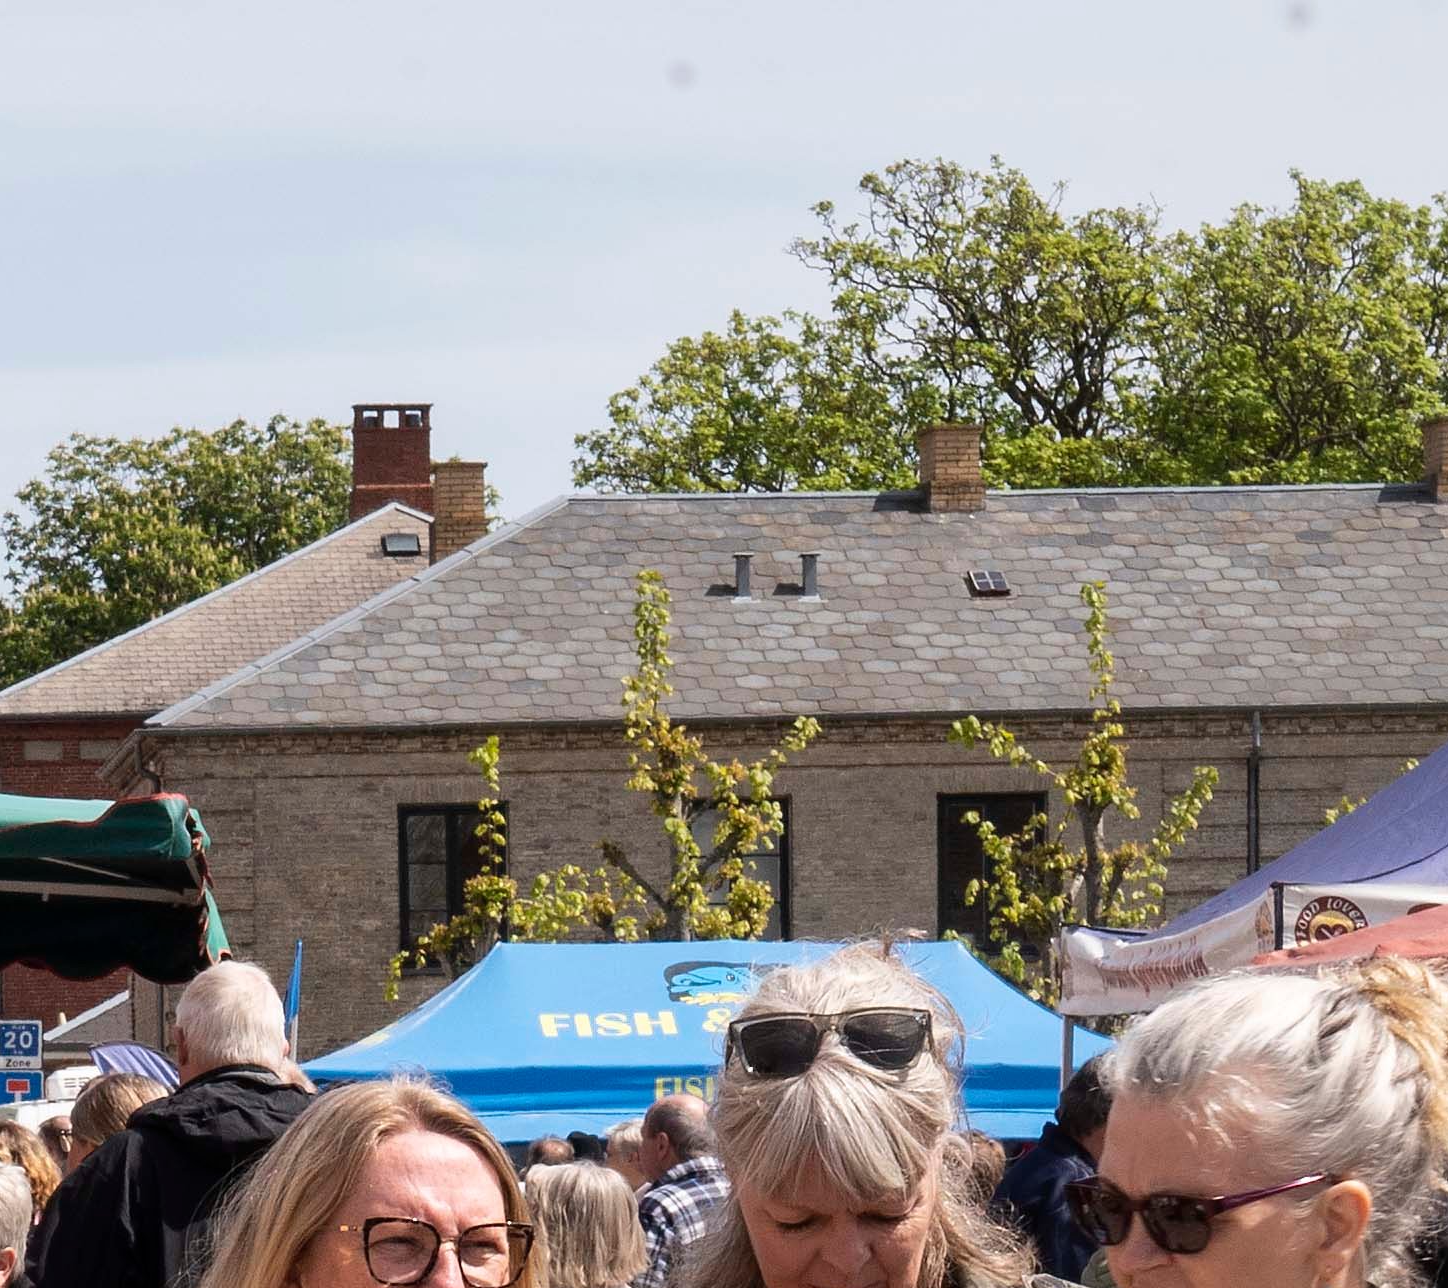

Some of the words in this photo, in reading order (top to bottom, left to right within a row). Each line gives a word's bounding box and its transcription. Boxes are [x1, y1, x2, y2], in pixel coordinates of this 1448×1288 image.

[539, 1010, 679, 1039] FISH
[702, 1007, 732, 1034] &
[4, 1031, 33, 1049] 20
[5, 1058, 31, 1068] Zone
